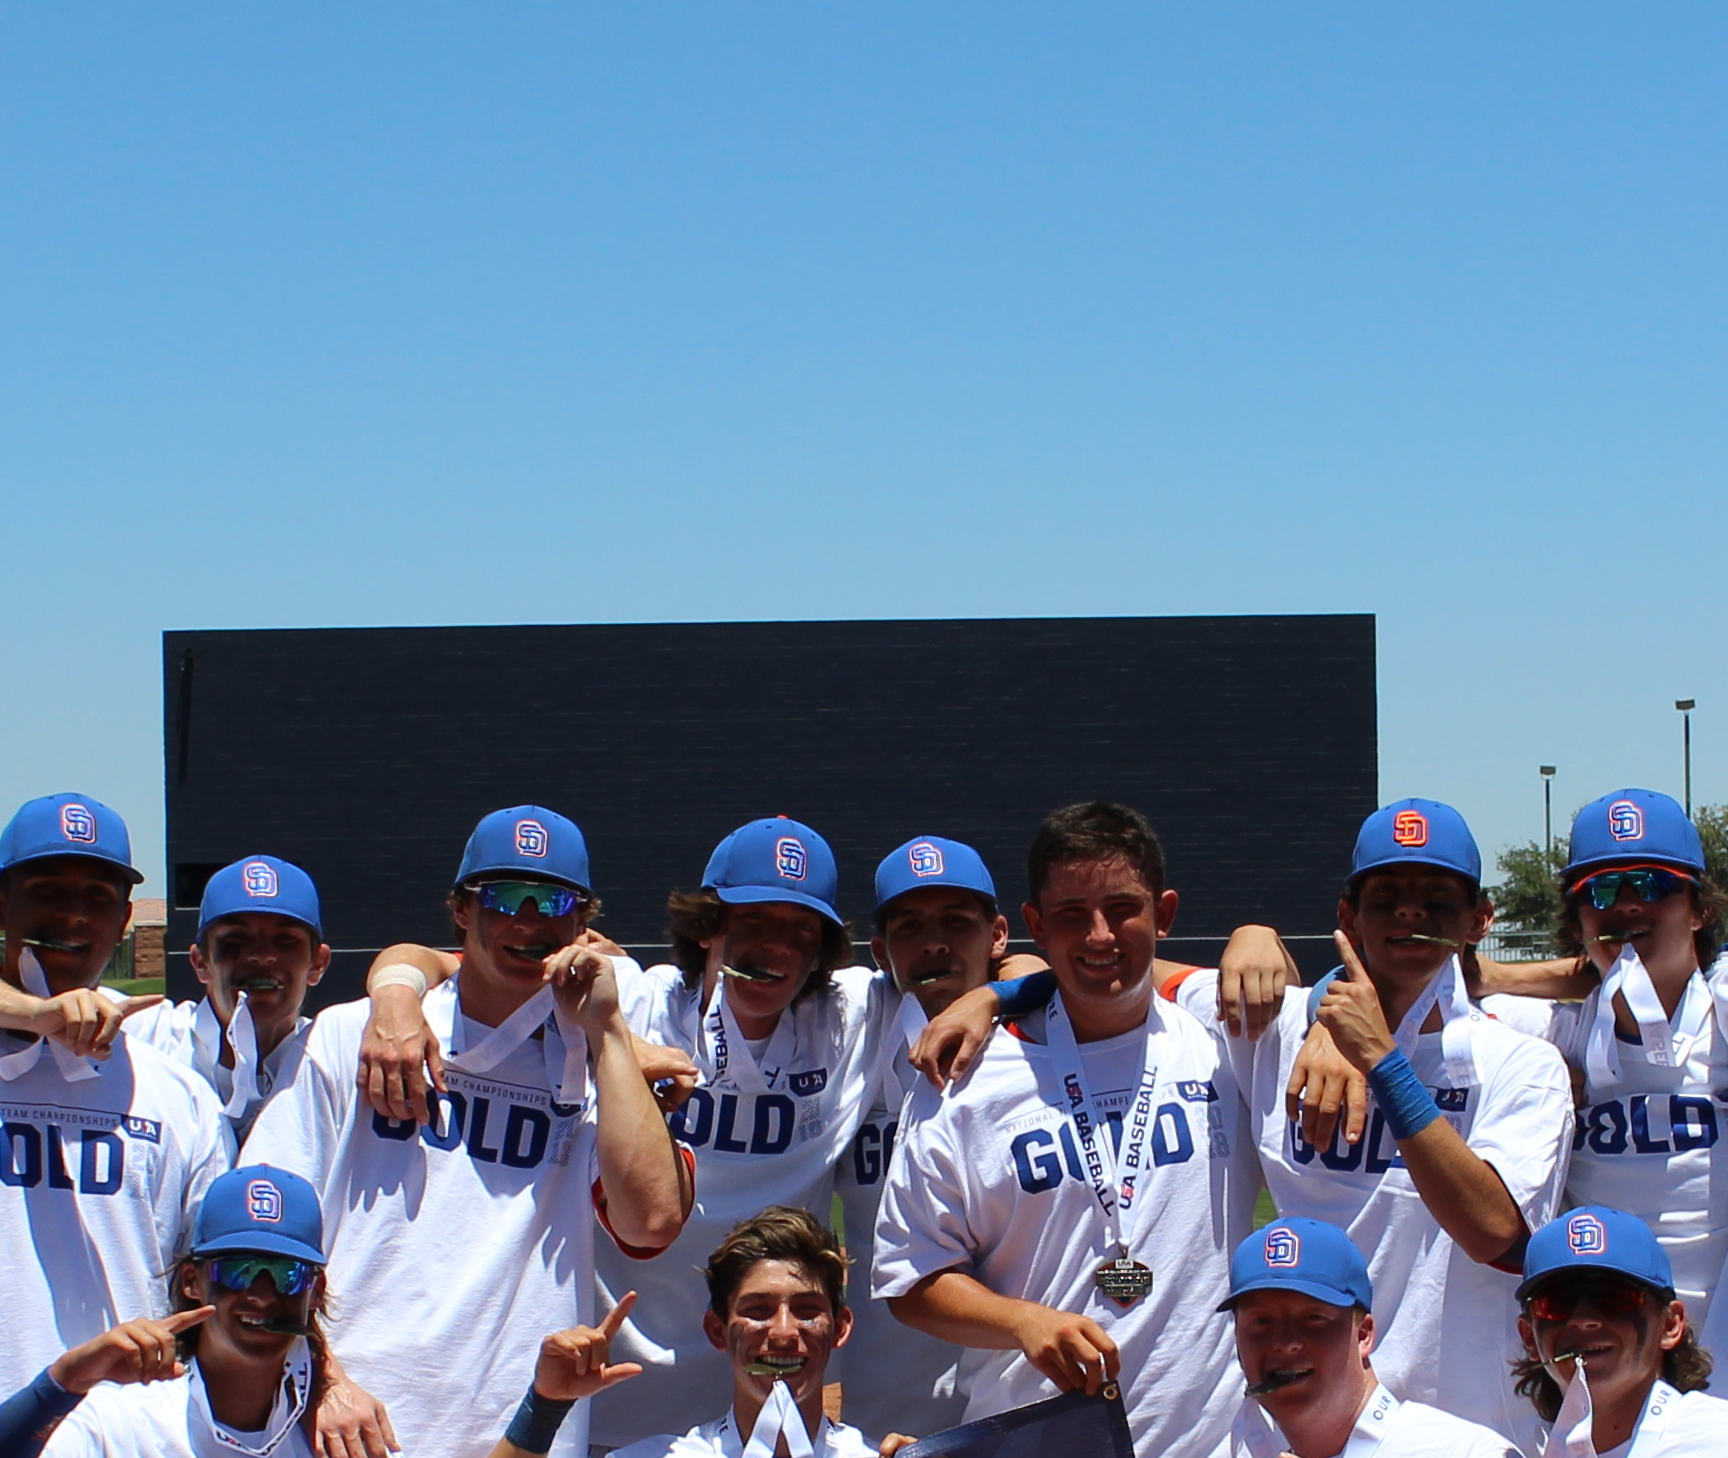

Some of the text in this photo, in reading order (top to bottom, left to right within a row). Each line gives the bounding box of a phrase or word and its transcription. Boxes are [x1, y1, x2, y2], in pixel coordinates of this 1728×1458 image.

[704, 1003, 729, 1083] SEBALL
[463, 1079, 547, 1106] CHAMPIONSHIPS
[2, 1108, 29, 1119] TEAM
[33, 1109, 118, 1127] CHAMPIONSHIPS
[670, 1087, 797, 1155] OLD
[1004, 1113, 1055, 1134] NATIONAL
[1118, 1065, 1159, 1211] USA BASEBALL
[1574, 1095, 1719, 1155] OLD
[1063, 1072, 1116, 1218] USA BASEBALL
[1372, 1395, 1392, 1421] OUR
[1650, 1389, 1672, 1416] OUR
